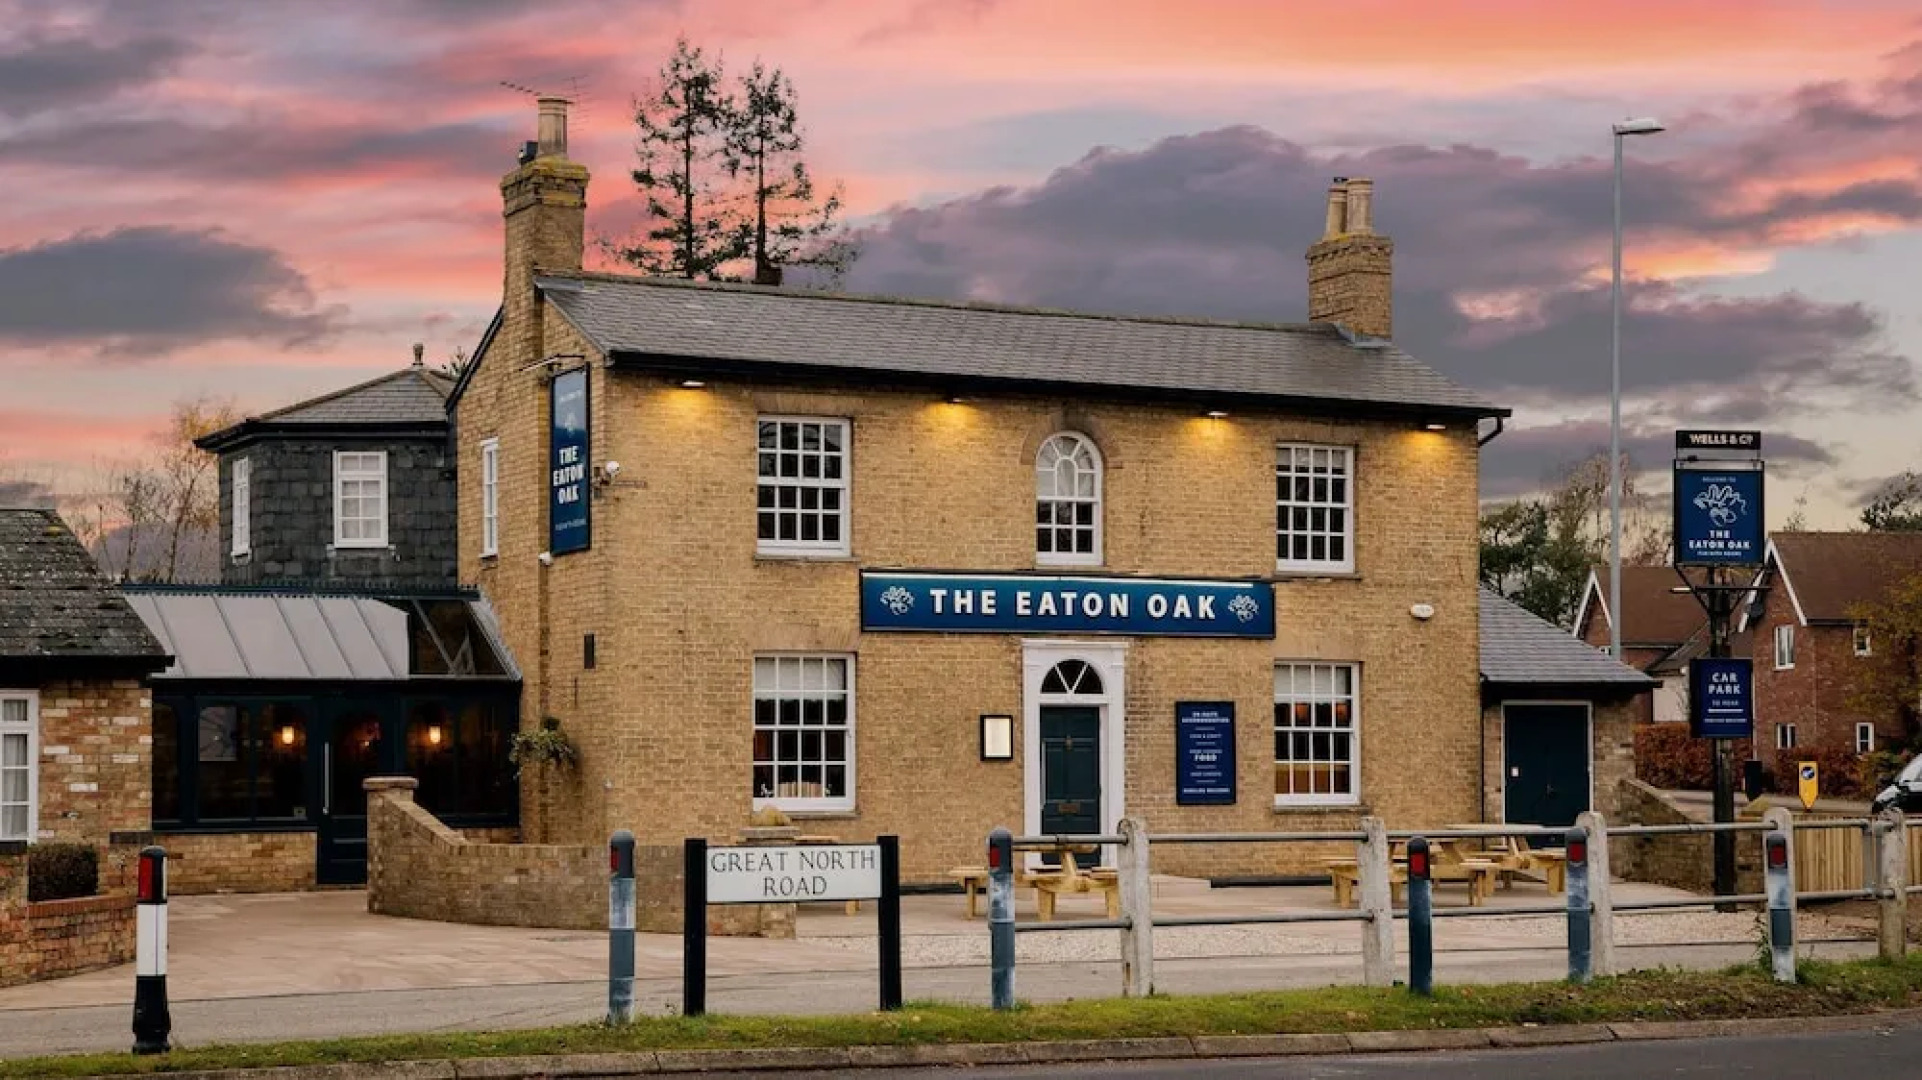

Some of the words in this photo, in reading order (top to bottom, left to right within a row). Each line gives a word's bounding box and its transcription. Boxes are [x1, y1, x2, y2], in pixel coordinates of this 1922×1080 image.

[1689, 433, 1726, 444] WELLS
[558, 445, 579, 464] THE
[553, 463, 584, 486] EATON
[558, 484, 579, 504] OAK
[1710, 530, 1730, 538] THE
[1689, 540, 1725, 549] EATON
[1728, 540, 1750, 549] OAK
[930, 589, 997, 615] THE
[1016, 591, 1130, 618] EATON
[1147, 594, 1216, 619] OAK
[1712, 672, 1738, 682] CAR
[1708, 684, 1742, 694] PARK
[710, 851, 788, 873] GREAT
[799, 850, 876, 872] NORTH
[763, 876, 827, 896] ROAD
